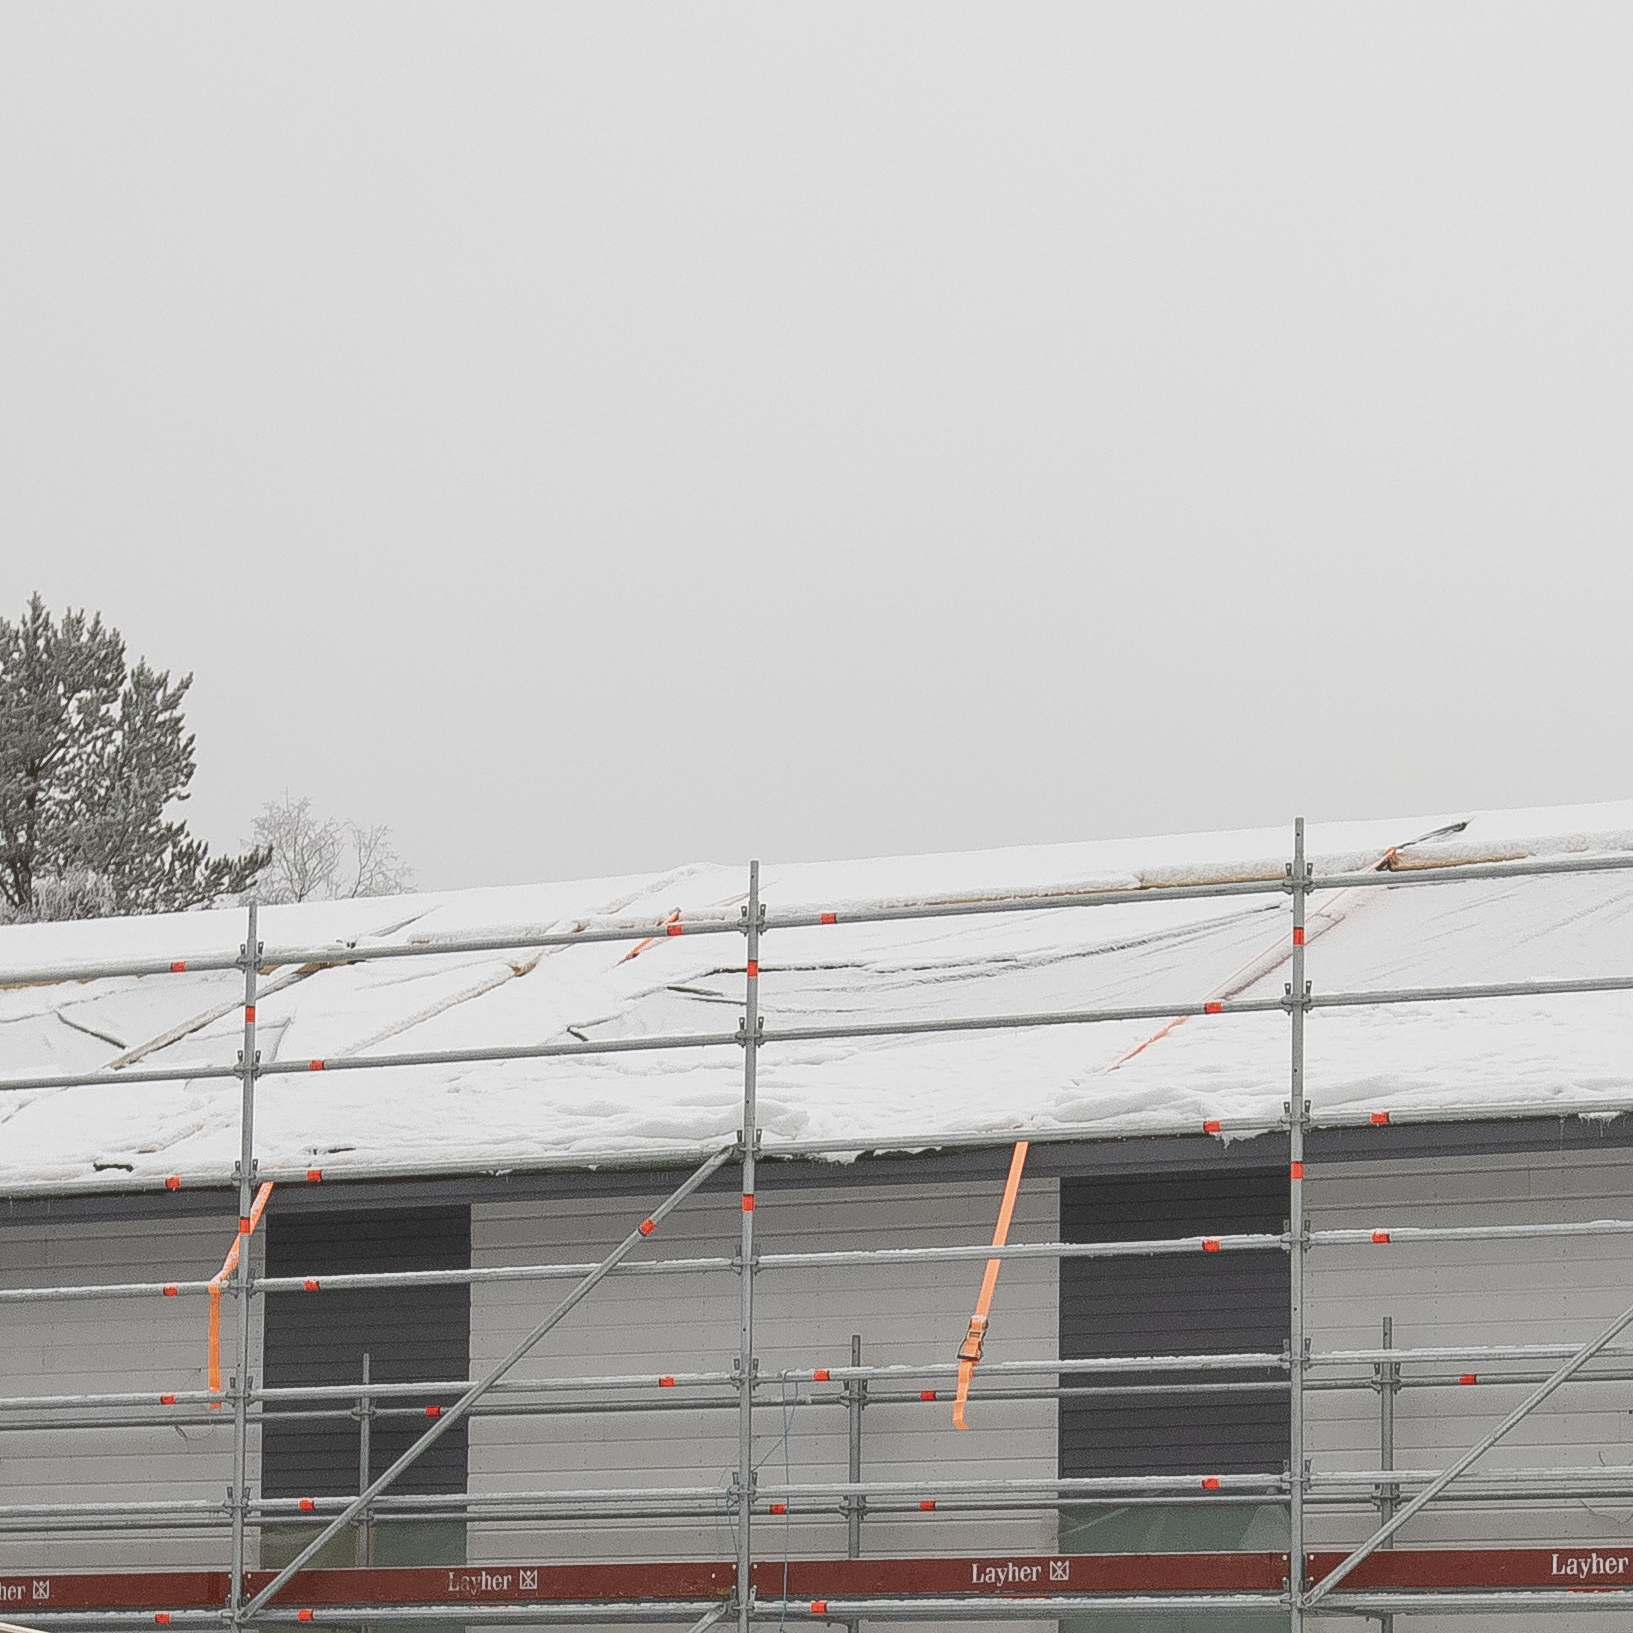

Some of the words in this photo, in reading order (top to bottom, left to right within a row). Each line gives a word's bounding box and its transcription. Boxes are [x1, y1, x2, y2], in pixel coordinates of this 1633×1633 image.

[971, 1562, 1042, 1586] Layher
[1551, 1553, 1629, 1579] Layher
[447, 1571, 512, 1594] Layher
